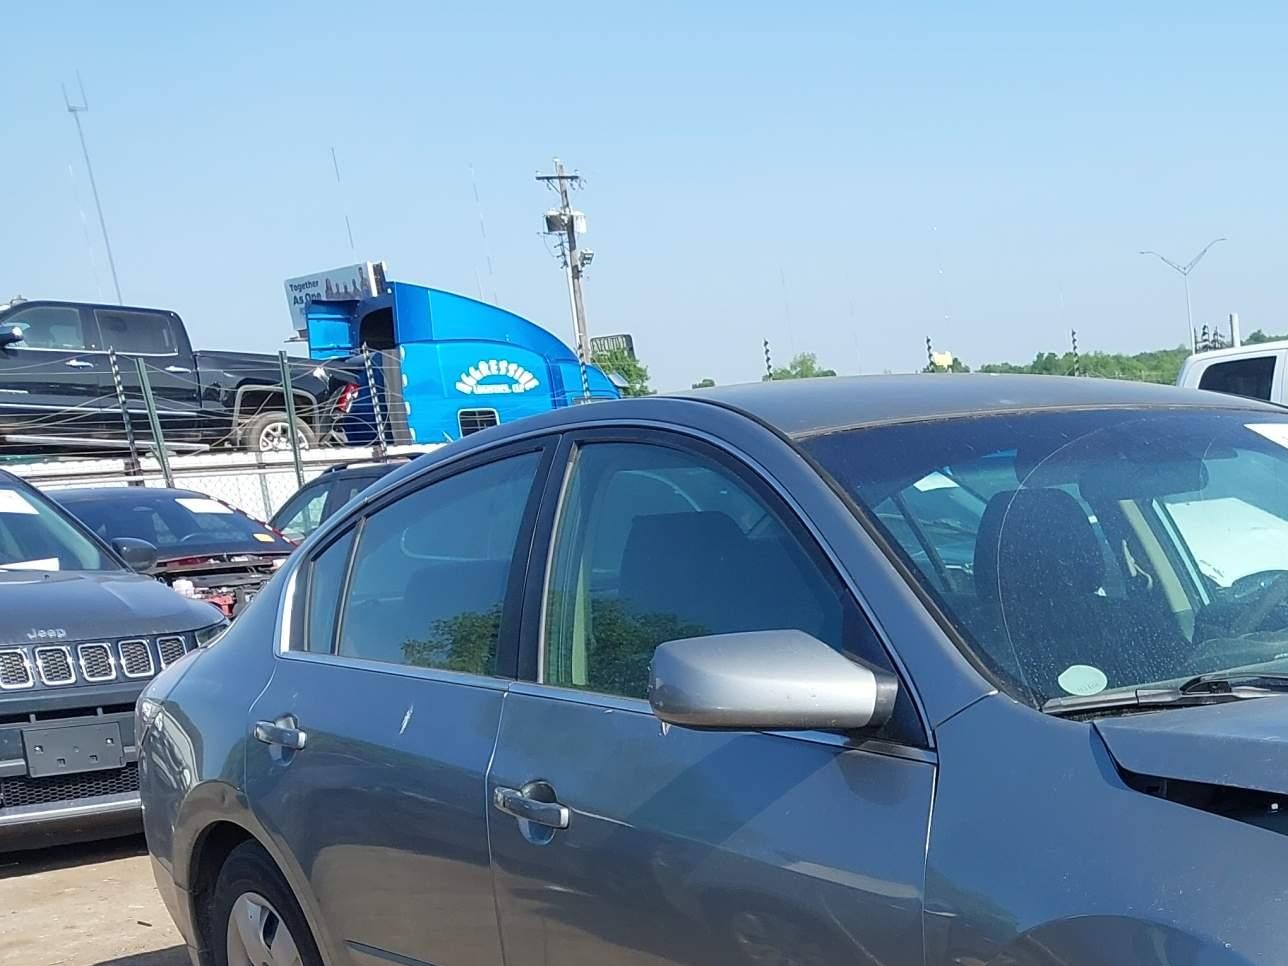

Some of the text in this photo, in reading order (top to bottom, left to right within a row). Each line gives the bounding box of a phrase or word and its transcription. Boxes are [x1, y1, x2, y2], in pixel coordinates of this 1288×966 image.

[289, 280, 319, 293] Together
[293, 295, 304, 305] As
[27, 628, 66, 640] Jeep
